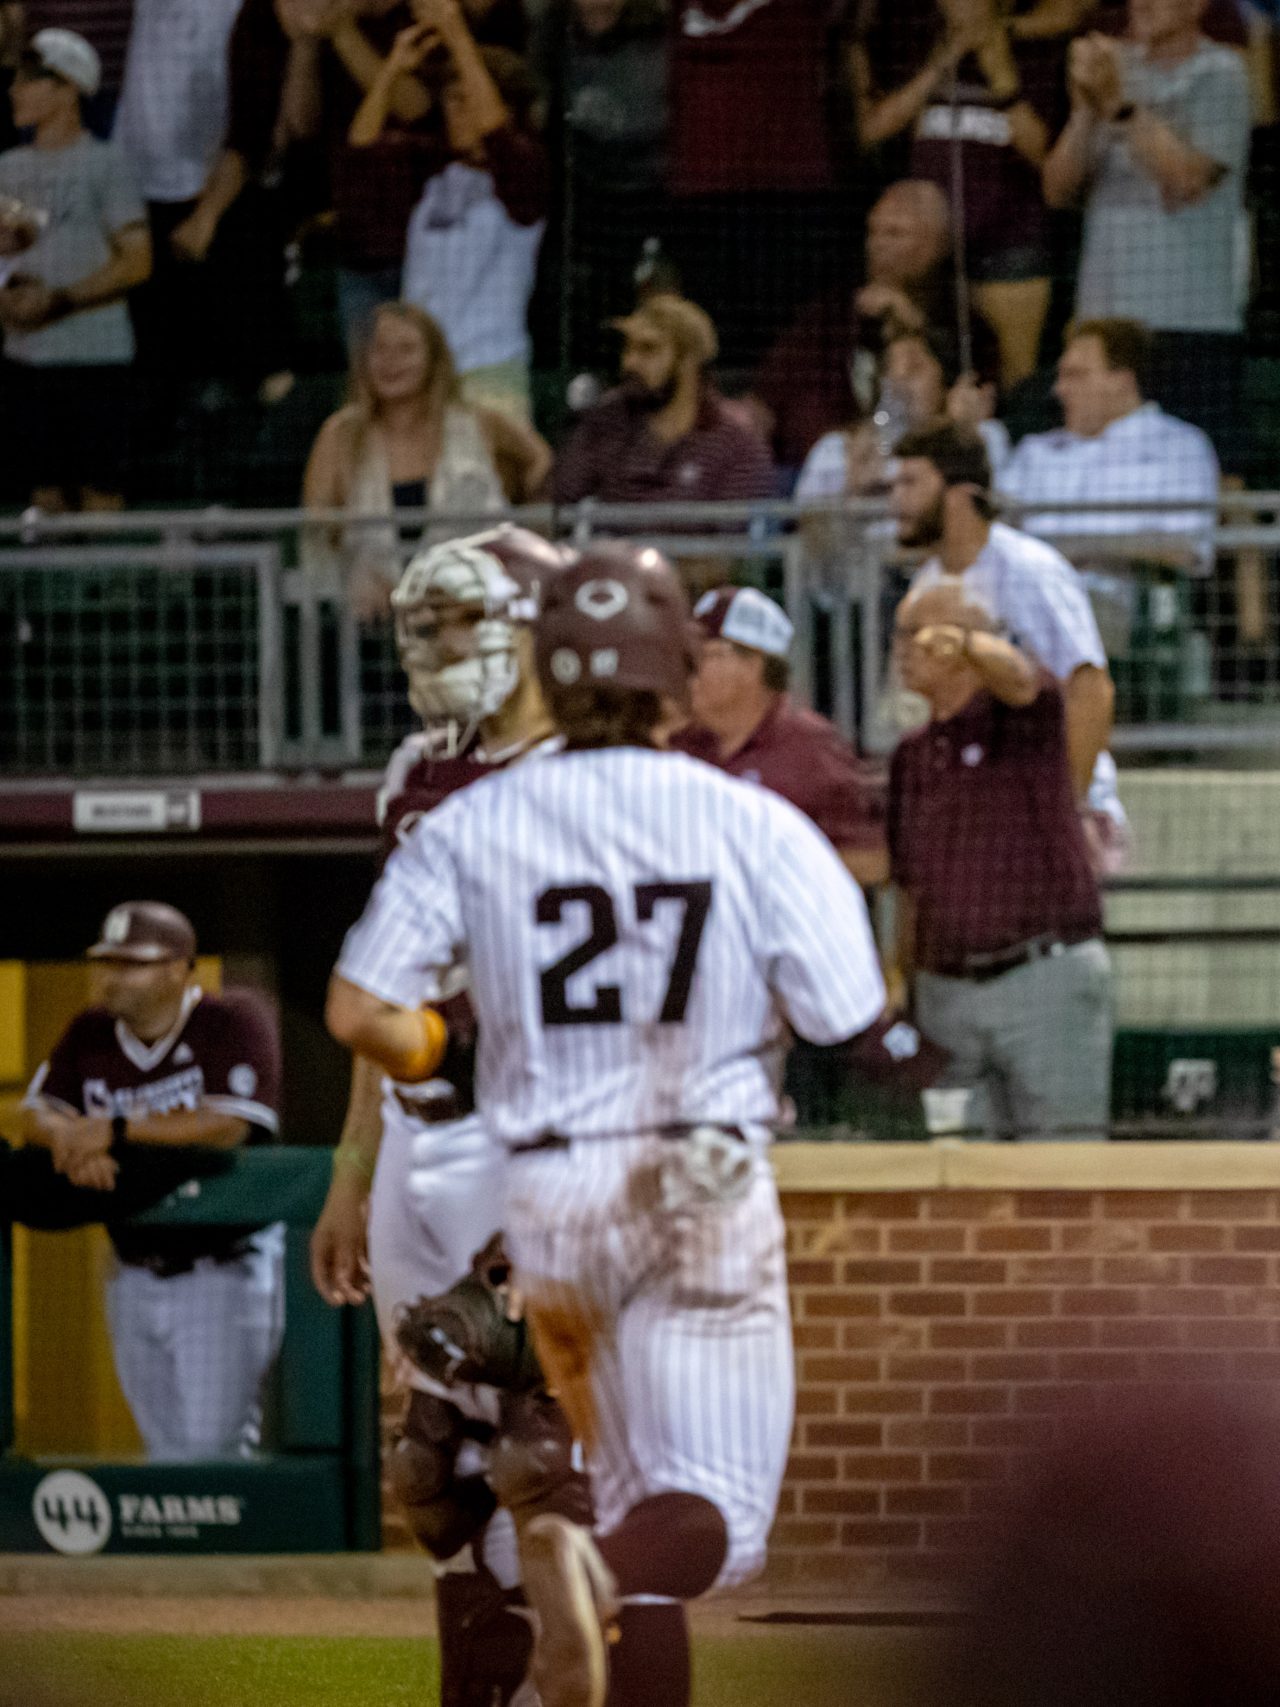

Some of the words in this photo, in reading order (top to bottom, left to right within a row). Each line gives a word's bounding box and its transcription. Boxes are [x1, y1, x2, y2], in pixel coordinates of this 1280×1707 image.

[536, 881, 712, 1024] 27
[41, 1496, 102, 1535] 44
[119, 1493, 240, 1525] FARMS
